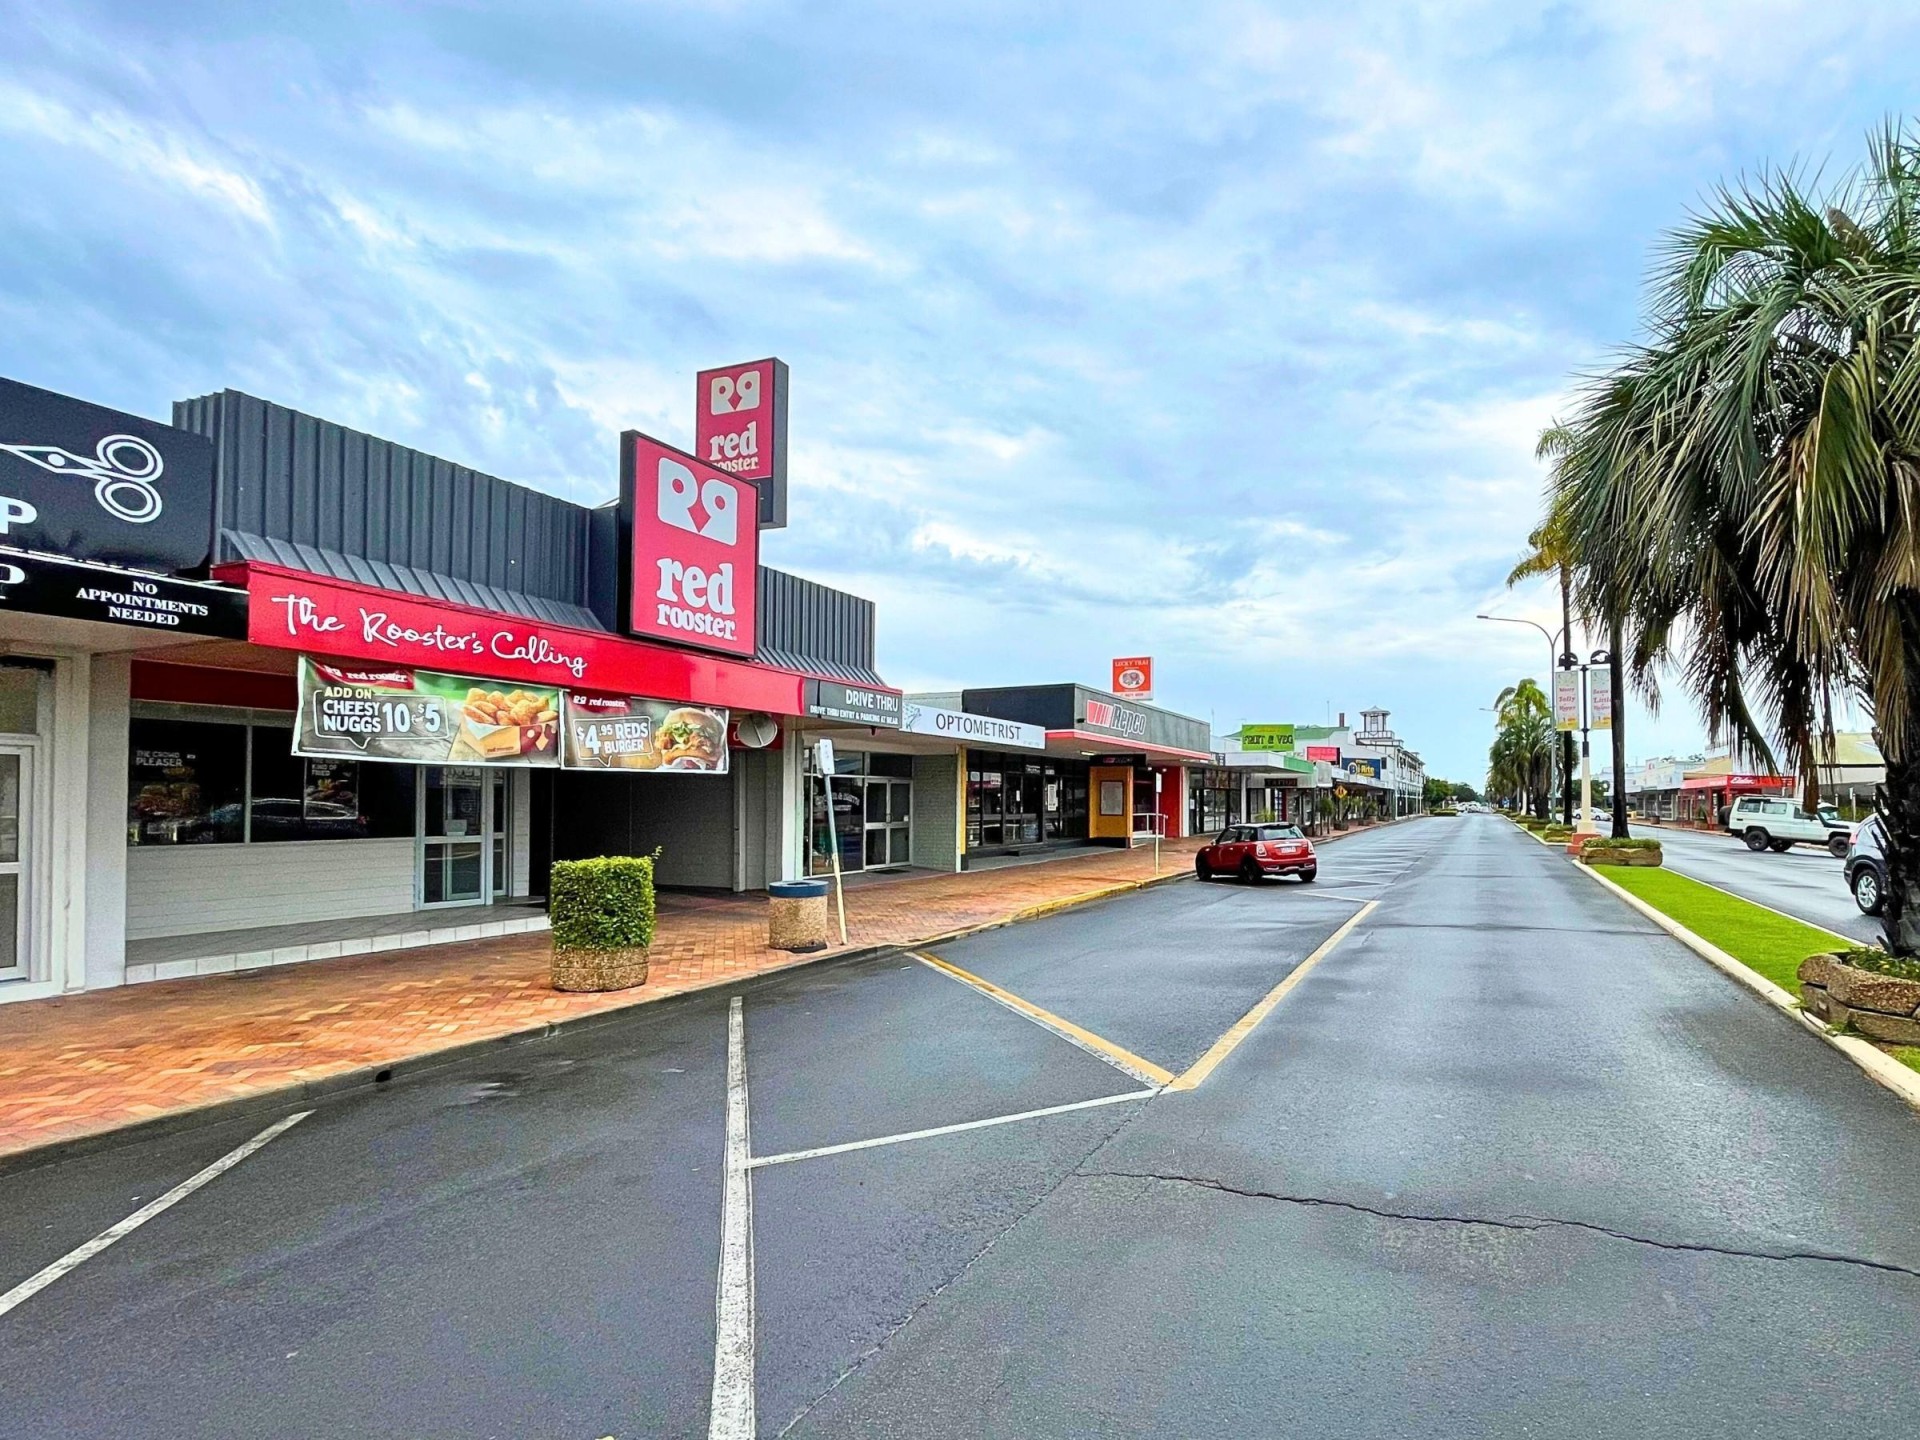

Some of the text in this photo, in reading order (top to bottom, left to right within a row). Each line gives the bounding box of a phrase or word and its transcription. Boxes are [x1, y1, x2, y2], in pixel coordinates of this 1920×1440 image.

[710, 421, 758, 461] red
[132, 581, 158, 595] NO
[656, 558, 736, 615] red
[76, 587, 209, 616] APPOINTMENTS
[108, 606, 180, 626] NEEDED
[656, 603, 736, 641] rooster
[271, 594, 588, 678] The Rooster's Calling
[346, 671, 369, 680] red
[324, 686, 372, 700] ADD ON
[588, 698, 602, 706] red
[845, 688, 898, 712] DRIVE THRU
[323, 699, 381, 716] CHEESY
[809, 704, 826, 715] DRIVE
[840, 709, 855, 719] ENTRY
[323, 715, 382, 733] NUGGS
[382, 702, 411, 733] 10
[936, 713, 1021, 740] OPTOMETRIST
[1111, 704, 1147, 737] Repco
[614, 722, 649, 740] REDS
[1243, 735, 1265, 745] FRUIT
[1276, 735, 1294, 745] VEG
[603, 738, 644, 754] BURGER
[136, 757, 183, 767] PLEASER
